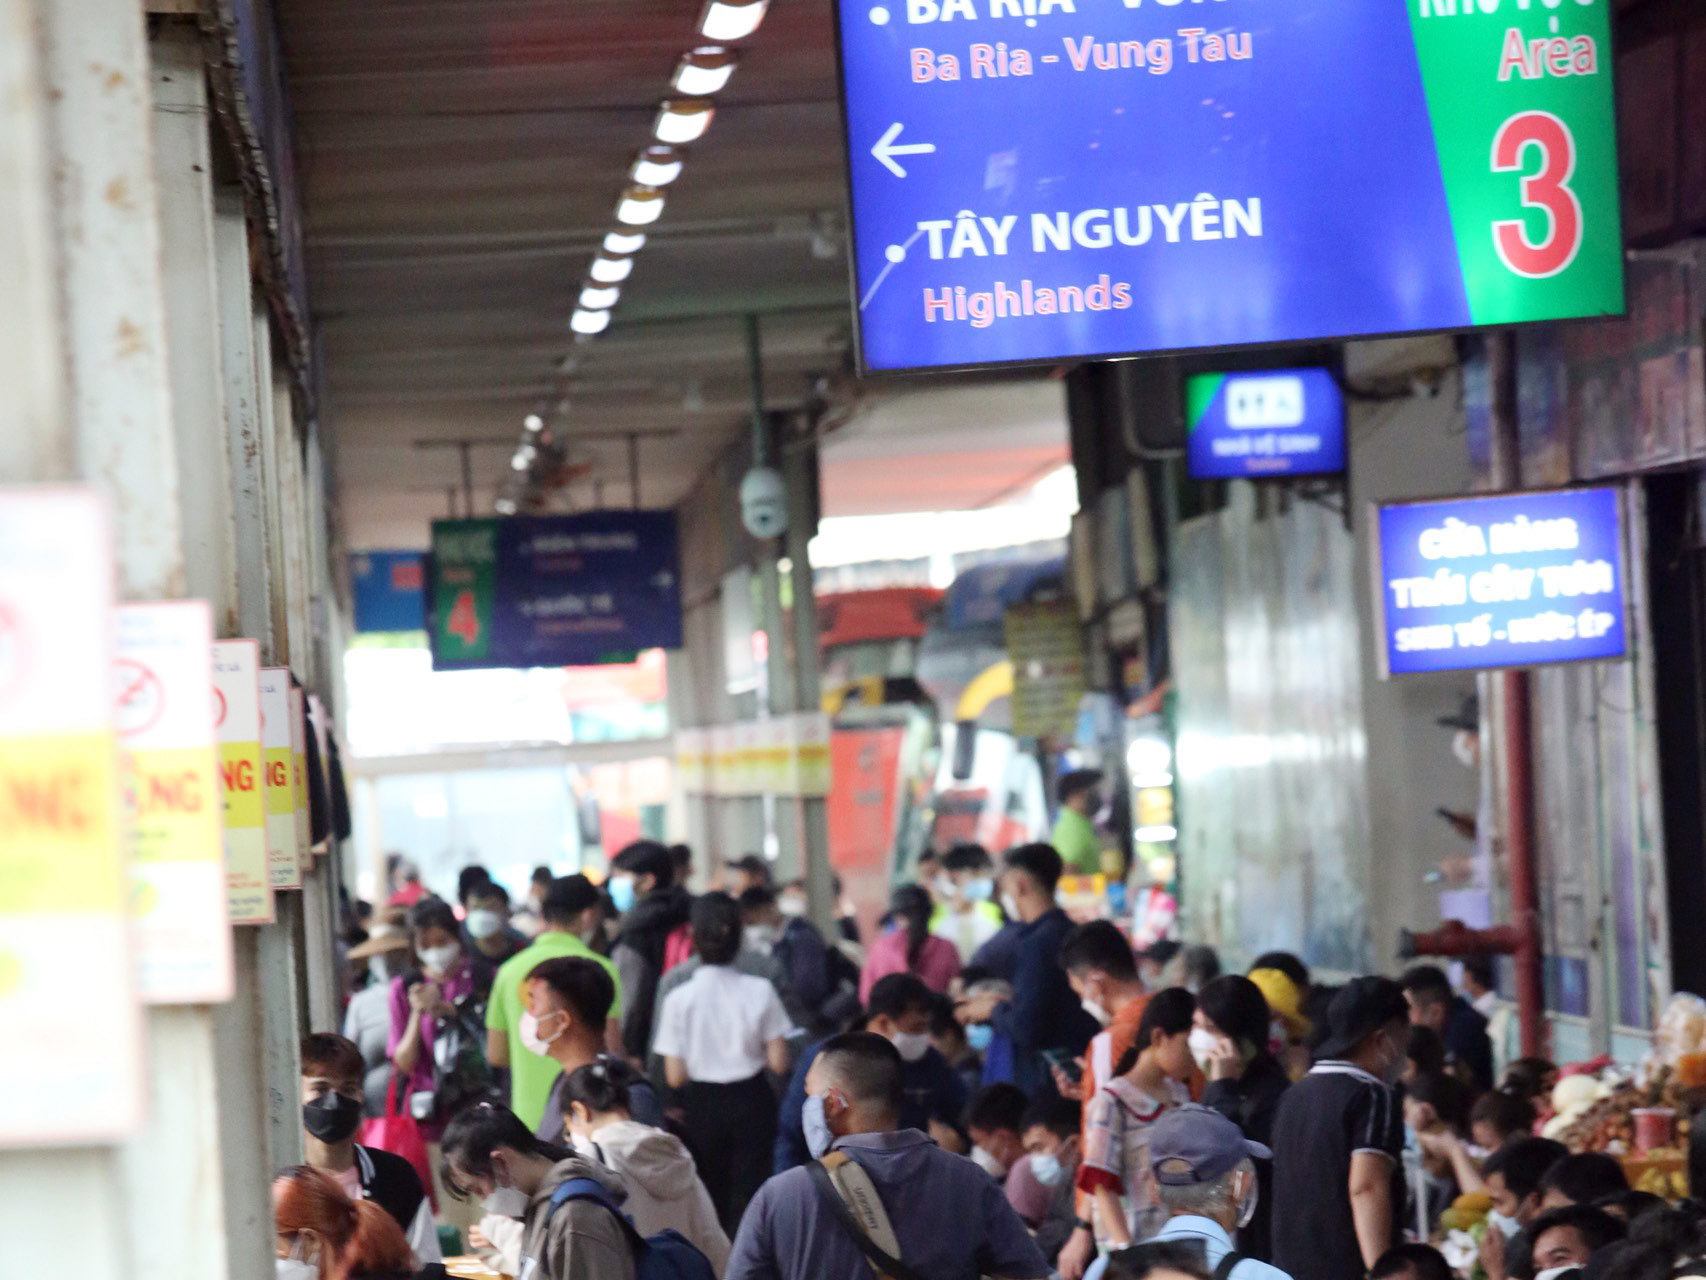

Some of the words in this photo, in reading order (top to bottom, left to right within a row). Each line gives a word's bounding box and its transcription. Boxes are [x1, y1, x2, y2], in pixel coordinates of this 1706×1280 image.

[910, 48, 961, 83] Ba
[969, 42, 1034, 78] Ria
[1041, 54, 1059, 63] -
[1063, 36, 1173, 75] Vung
[1177, 27, 1253, 63] Tau
[1496, 27, 1598, 81] Area
[1489, 109, 1584, 279] 3
[917, 210, 1018, 259] TÂY
[1031, 192, 1263, 252] NGUYÊN
[923, 273, 1133, 329] Highlands
[448, 591, 479, 645] 4
